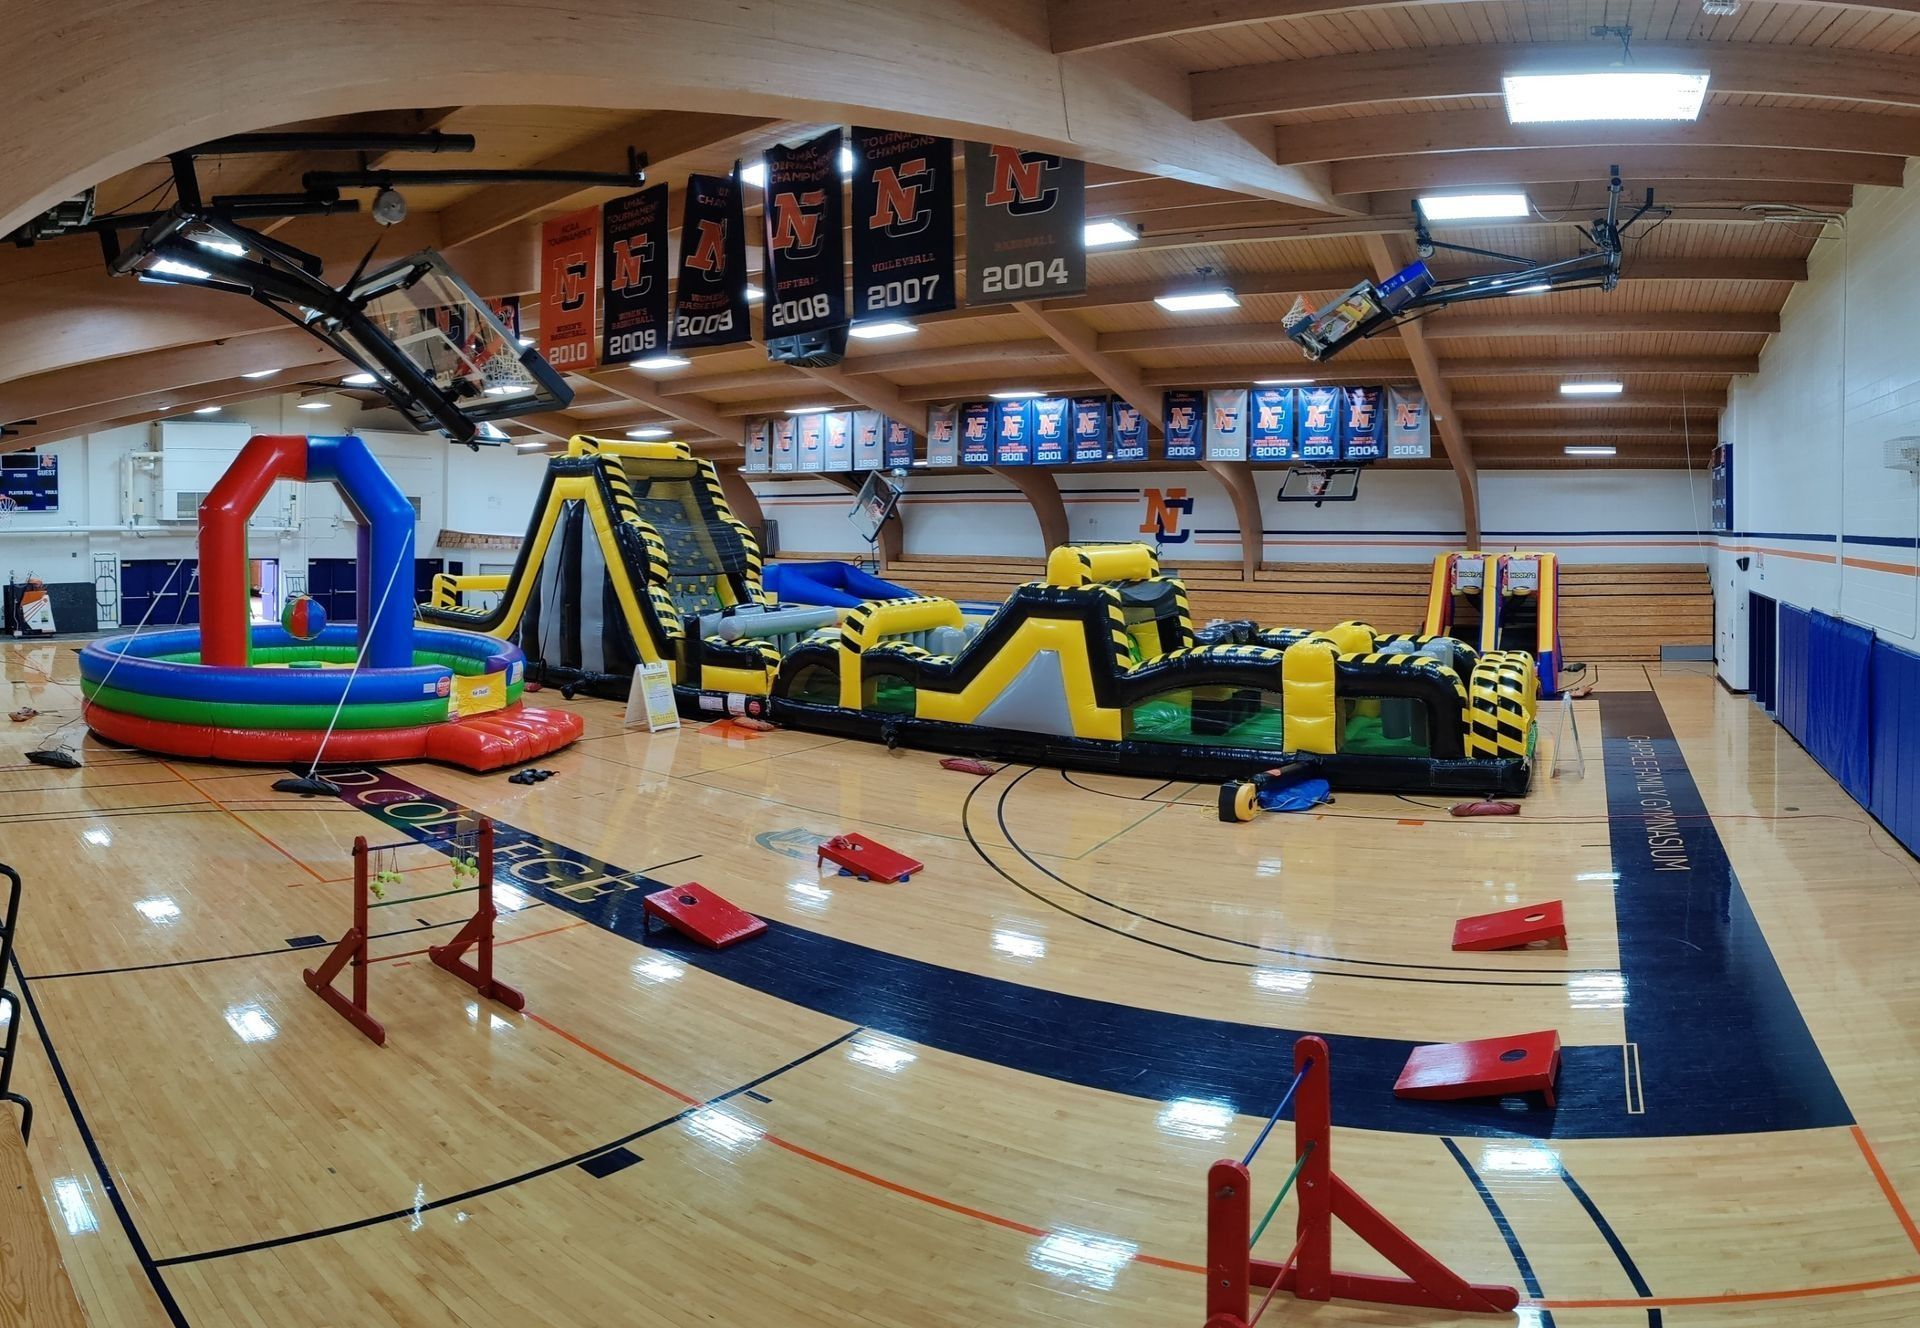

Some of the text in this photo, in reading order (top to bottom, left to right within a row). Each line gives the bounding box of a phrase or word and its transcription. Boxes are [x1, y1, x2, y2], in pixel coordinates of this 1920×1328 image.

[983, 258, 1069, 293] 2004
[867, 274, 940, 311] 2007
[772, 293, 830, 327] 2008
[609, 329, 657, 356] 2009
[549, 342, 588, 365] 2010
[1076, 449, 1102, 459] 2002
[1117, 447, 1144, 457] 2002
[1168, 446, 1195, 456] 2003
[1211, 448, 1240, 457] 2003
[1256, 446, 1287, 456] 2003
[1303, 445, 1334, 455] 2004
[1348, 445, 1379, 456] 2004
[1393, 445, 1424, 455] 2004
[964, 453, 988, 462] 2000
[1001, 452, 1024, 461] 2001
[1037, 451, 1061, 460] 2001
[889, 457, 909, 466] 1999
[1139, 487, 1194, 544] NC
[1633, 766, 1668, 797] FAMILY
[1640, 798, 1691, 871] GYMNASIUM
